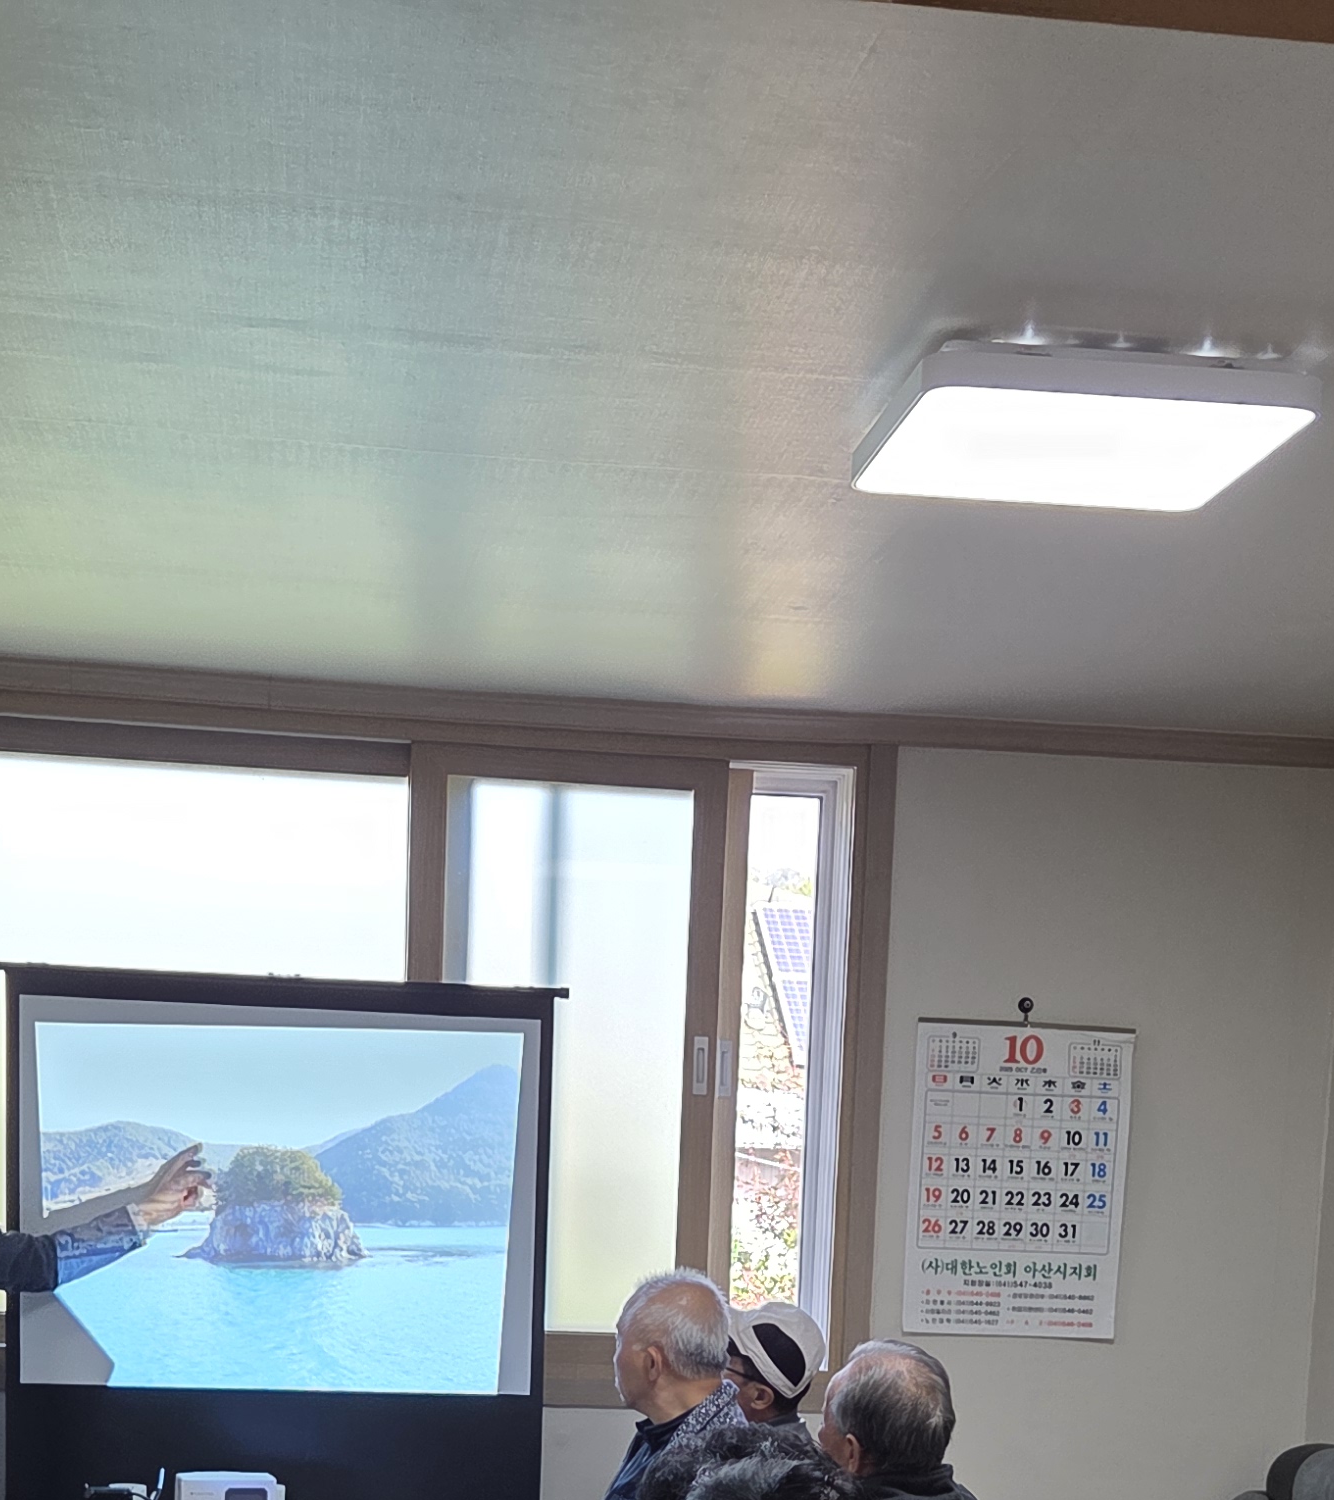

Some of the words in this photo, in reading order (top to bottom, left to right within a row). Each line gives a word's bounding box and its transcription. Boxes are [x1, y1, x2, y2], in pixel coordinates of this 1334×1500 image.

[1003, 1034, 1045, 1065] 10
[987, 1077, 1002, 1086] 火
[1015, 1078, 1030, 1087] 水
[1042, 1079, 1057, 1088] 木
[1098, 1082, 1112, 1091] 土
[1017, 1097, 1024, 1112] 1
[1043, 1099, 1054, 1113] 2
[1069, 1099, 1081, 1114] 3
[1097, 1100, 1108, 1115] 4
[932, 1124, 942, 1139] 5
[958, 1126, 969, 1141] 6
[986, 1128, 996, 1142] 7
[1013, 1128, 1022, 1143] 8
[1039, 1130, 1052, 1145] 9
[1065, 1131, 1082, 1146] 10
[1094, 1132, 1108, 1147] 11
[927, 1157, 944, 1171] 12
[954, 1158, 970, 1173] 13
[981, 1159, 997, 1174] 14
[1008, 1160, 1023, 1175] 15
[1035, 1161, 1052, 1176] 16
[1063, 1162, 1080, 1177] 17
[1090, 1163, 1107, 1178] 18
[925, 1188, 942, 1202] 19
[951, 1189, 970, 1204] 20
[979, 1190, 997, 1205] 21
[1004, 1191, 1024, 1206] 22
[1031, 1192, 1052, 1207] 23
[1059, 1194, 1079, 1208] 24
[1086, 1194, 1107, 1209] 25
[922, 1219, 942, 1233] 26
[949, 1220, 968, 1235] 27
[976, 1221, 996, 1236] 28
[1003, 1222, 1023, 1236] 29
[1029, 1223, 1050, 1238] 30
[1058, 1224, 1076, 1239] 31
[921, 1258, 1017, 1278] (사)대한노인회
[1023, 1262, 1097, 1281] 아산시지회
